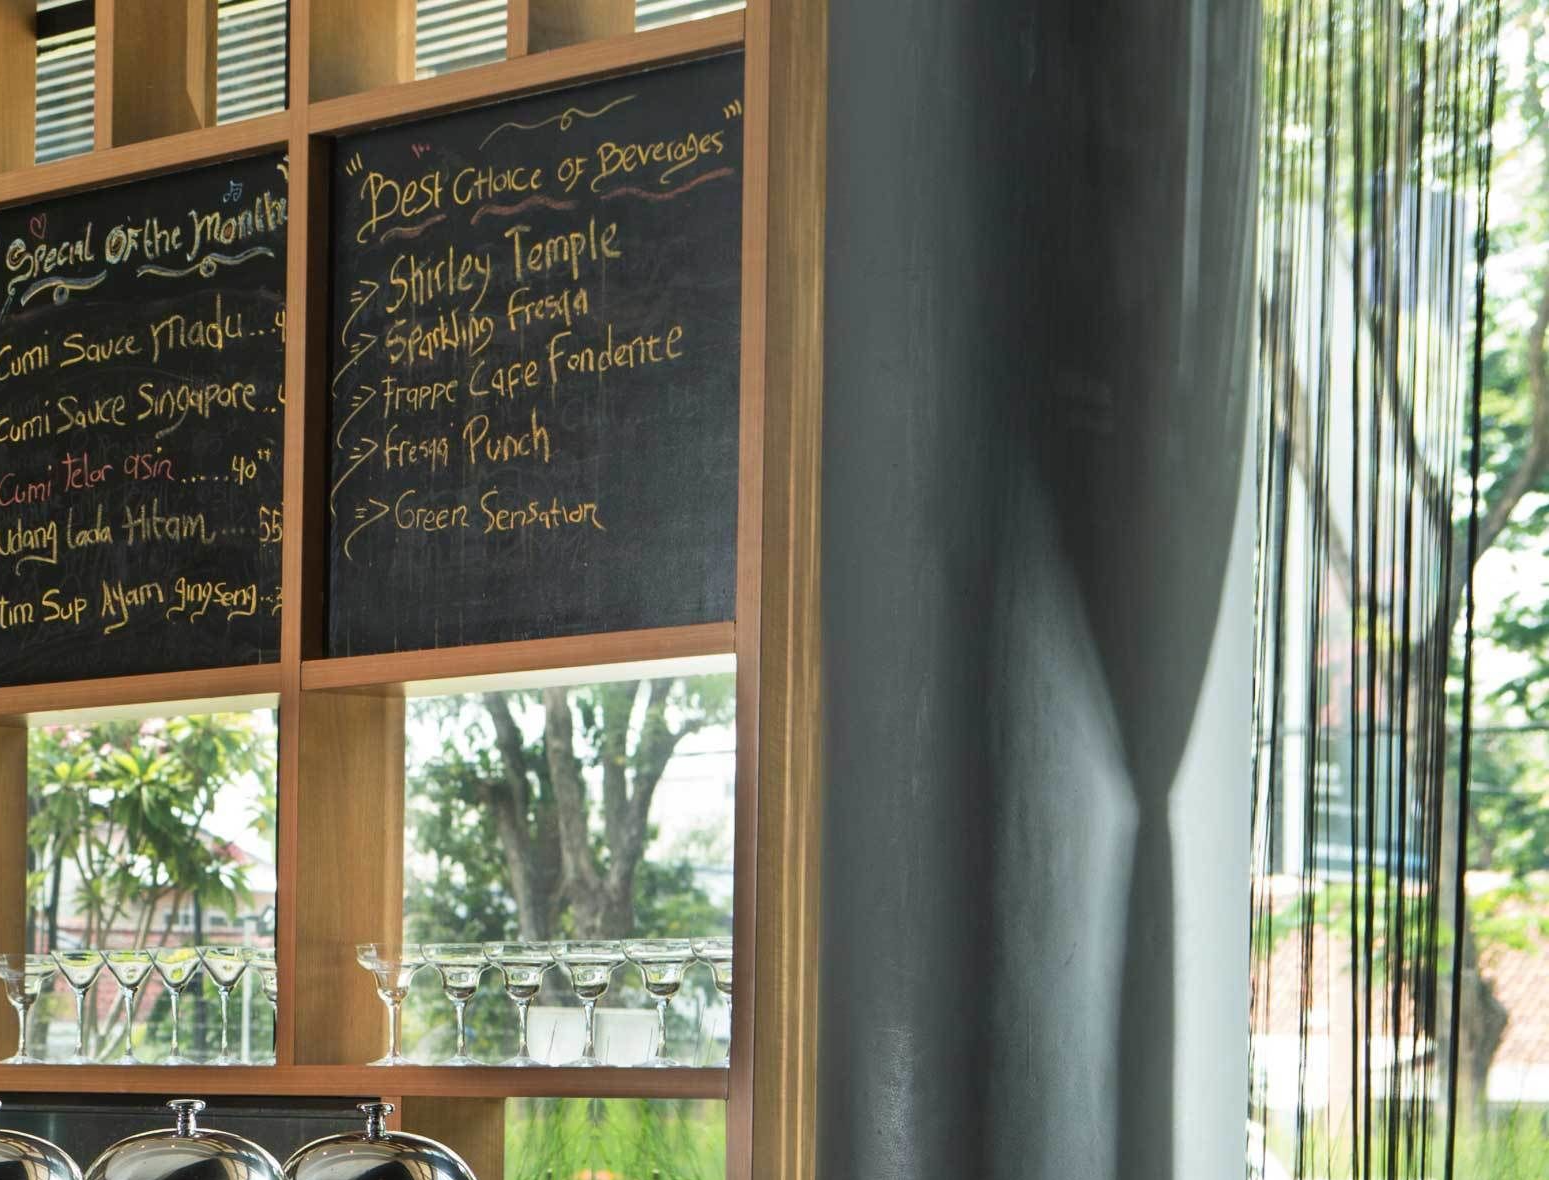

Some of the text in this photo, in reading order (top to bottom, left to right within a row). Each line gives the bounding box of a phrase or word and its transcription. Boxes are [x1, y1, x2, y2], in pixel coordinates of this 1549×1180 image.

[385, 214, 621, 314] Shirley Temple
[60, 333, 141, 368] Sauce
[384, 313, 494, 366] Sparkling
[57, 396, 126, 433] Sauce
[138, 382, 256, 438] Singapore
[462, 407, 551, 465] Punch
[122, 497, 216, 546] Hitam
[395, 487, 607, 534] Green Sensation
[42, 588, 87, 625] Sup
[101, 579, 164, 635] Ayam
